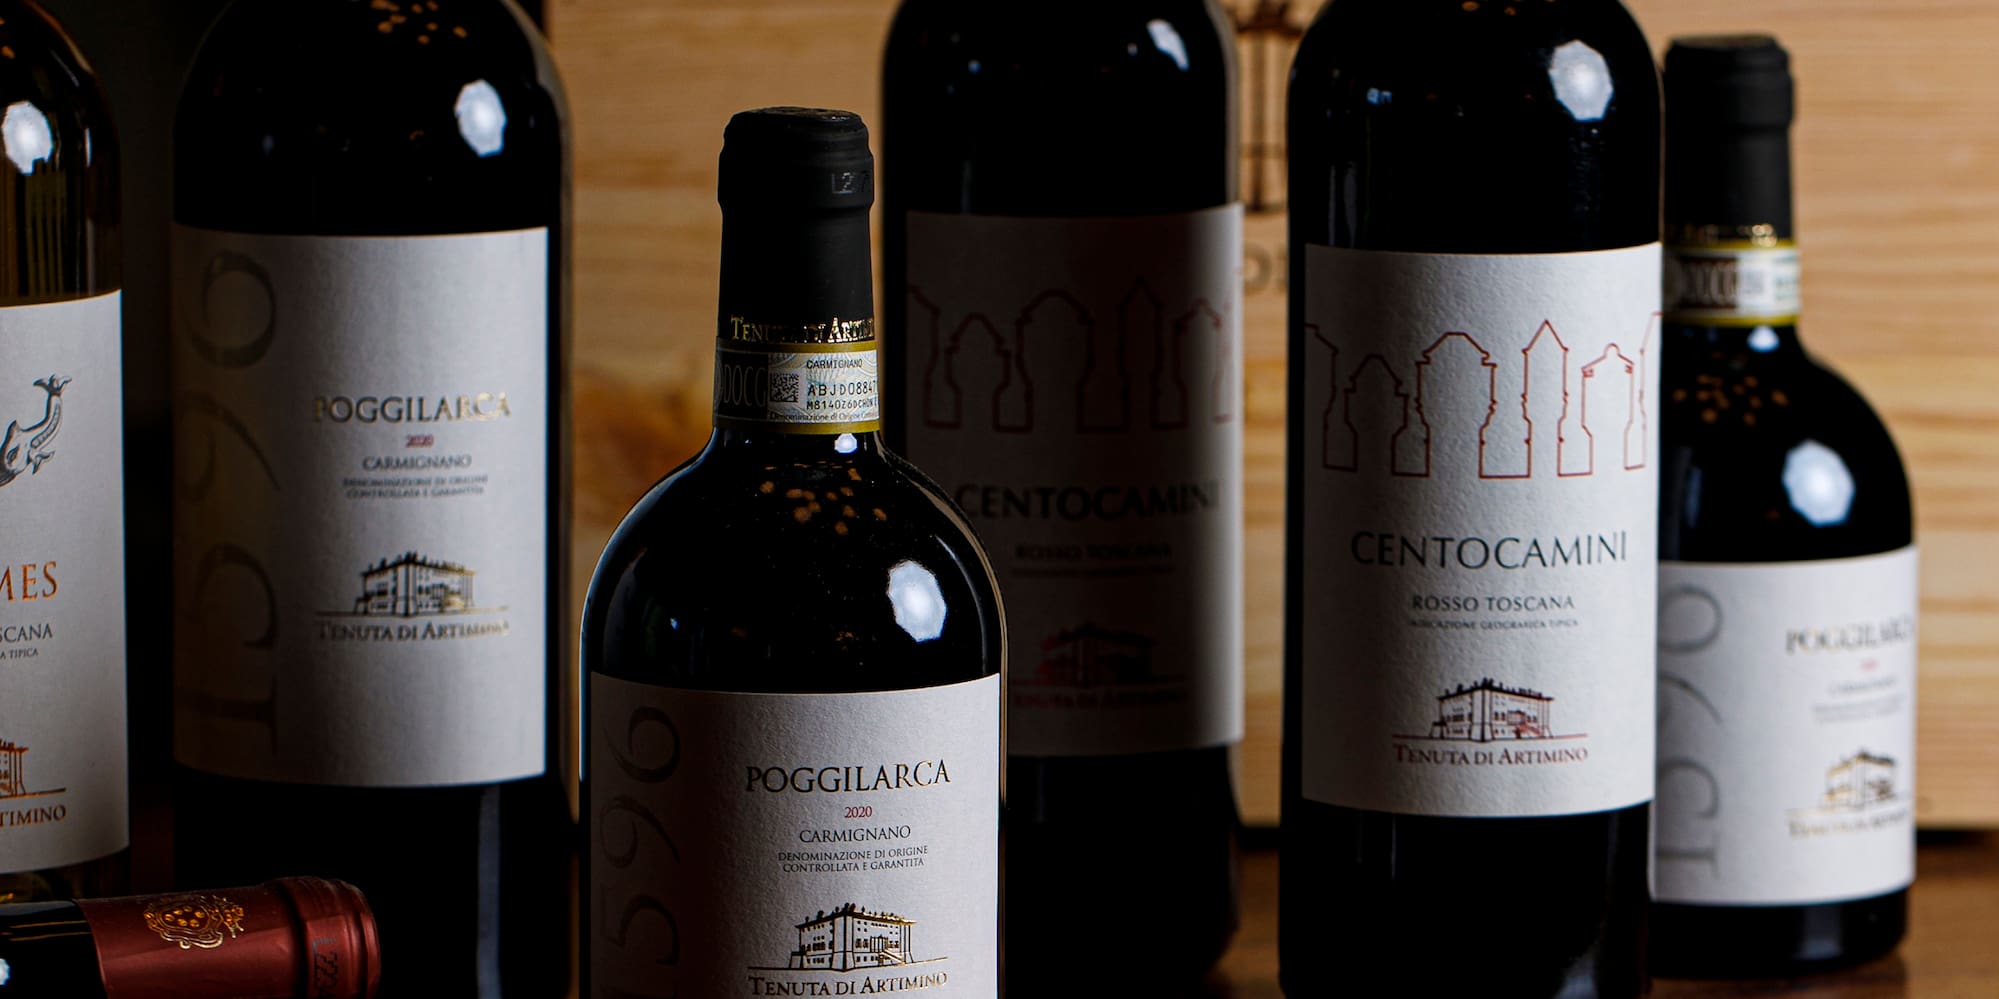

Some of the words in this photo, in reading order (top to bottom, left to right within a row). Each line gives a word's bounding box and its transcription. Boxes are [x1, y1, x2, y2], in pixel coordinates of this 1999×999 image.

[806, 358, 863, 369] CARMIGNANO
[313, 391, 512, 424] POGGILARCA
[405, 434, 435, 448] 2020
[362, 454, 473, 471] CARMIGNANO
[178, 249, 280, 756] 1596
[954, 481, 1220, 521] CENTOCAMINI
[1350, 530, 1627, 570] CENTOCAMINI
[1411, 596, 1478, 612] ROSSO
[1487, 595, 1575, 612] TOSCANA
[0, 623, 53, 643] CANA
[314, 621, 393, 641] TENUTA
[398, 625, 416, 640] DI
[421, 621, 509, 640] ARTIMINO
[9, 648, 38, 658] TIPICA
[1393, 744, 1470, 765] TENUTA
[1474, 751, 1493, 765] DI
[1500, 747, 1588, 765] ARTIMINO
[746, 760, 951, 792] POGGILARCA
[844, 806, 872, 818] 2020
[799, 825, 911, 843] CARMIGNANO
[778, 850, 870, 862] DENOMINAZIONE
[875, 850, 886, 858] DI
[889, 846, 928, 856] ORIGINE
[783, 863, 859, 873] CONTROLLATA
[863, 862, 868, 870] E
[870, 858, 924, 870] GARANTITA
[749, 977, 830, 996] TENUTA
[835, 981, 855, 995] DI
[860, 971, 948, 994] ARTIMINO
